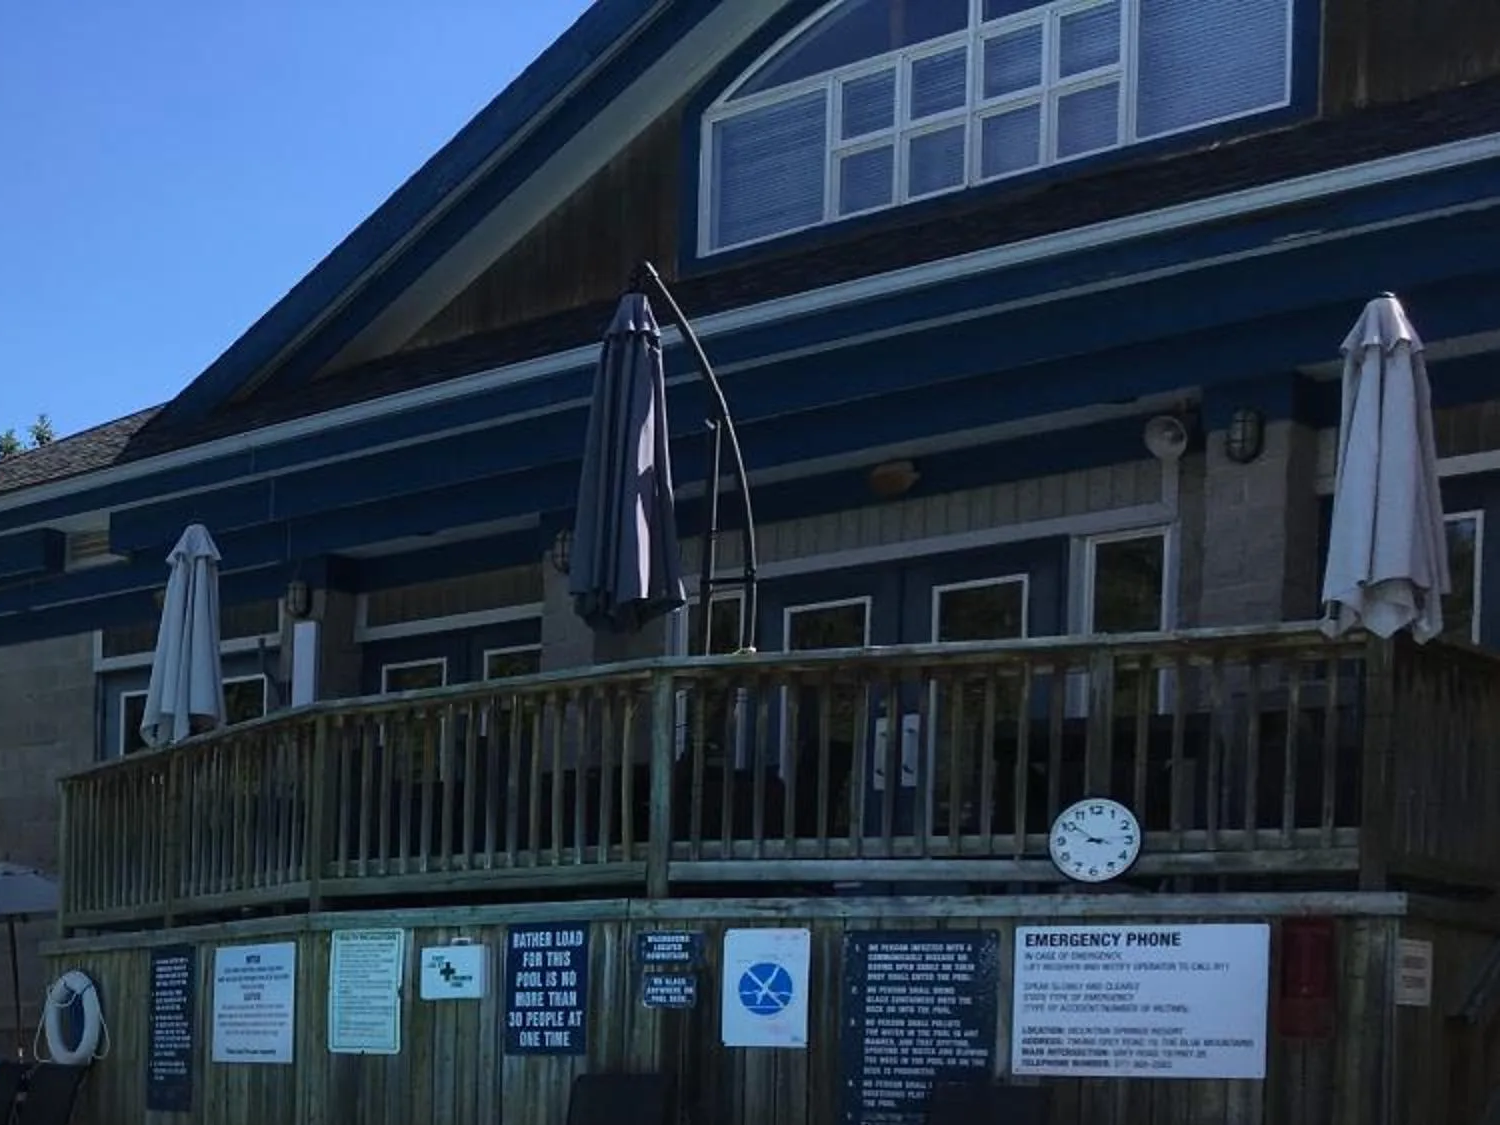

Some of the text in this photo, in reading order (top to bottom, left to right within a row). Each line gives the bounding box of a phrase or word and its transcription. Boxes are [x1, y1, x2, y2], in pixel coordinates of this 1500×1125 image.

[1121, 820, 1130, 830] 2
[1118, 850, 1127, 860] 4
[513, 930, 583, 948] BATHER LOAD
[1025, 931, 1181, 948] EMERGENCY PHONE
[523, 951, 570, 967] FOR THIS
[516, 970, 576, 987] POOL IS NO
[515, 991, 577, 1007] MORE THAN
[508, 1011, 582, 1027] 30 PEOPLE AT
[519, 1031, 570, 1047] ONE TIME
